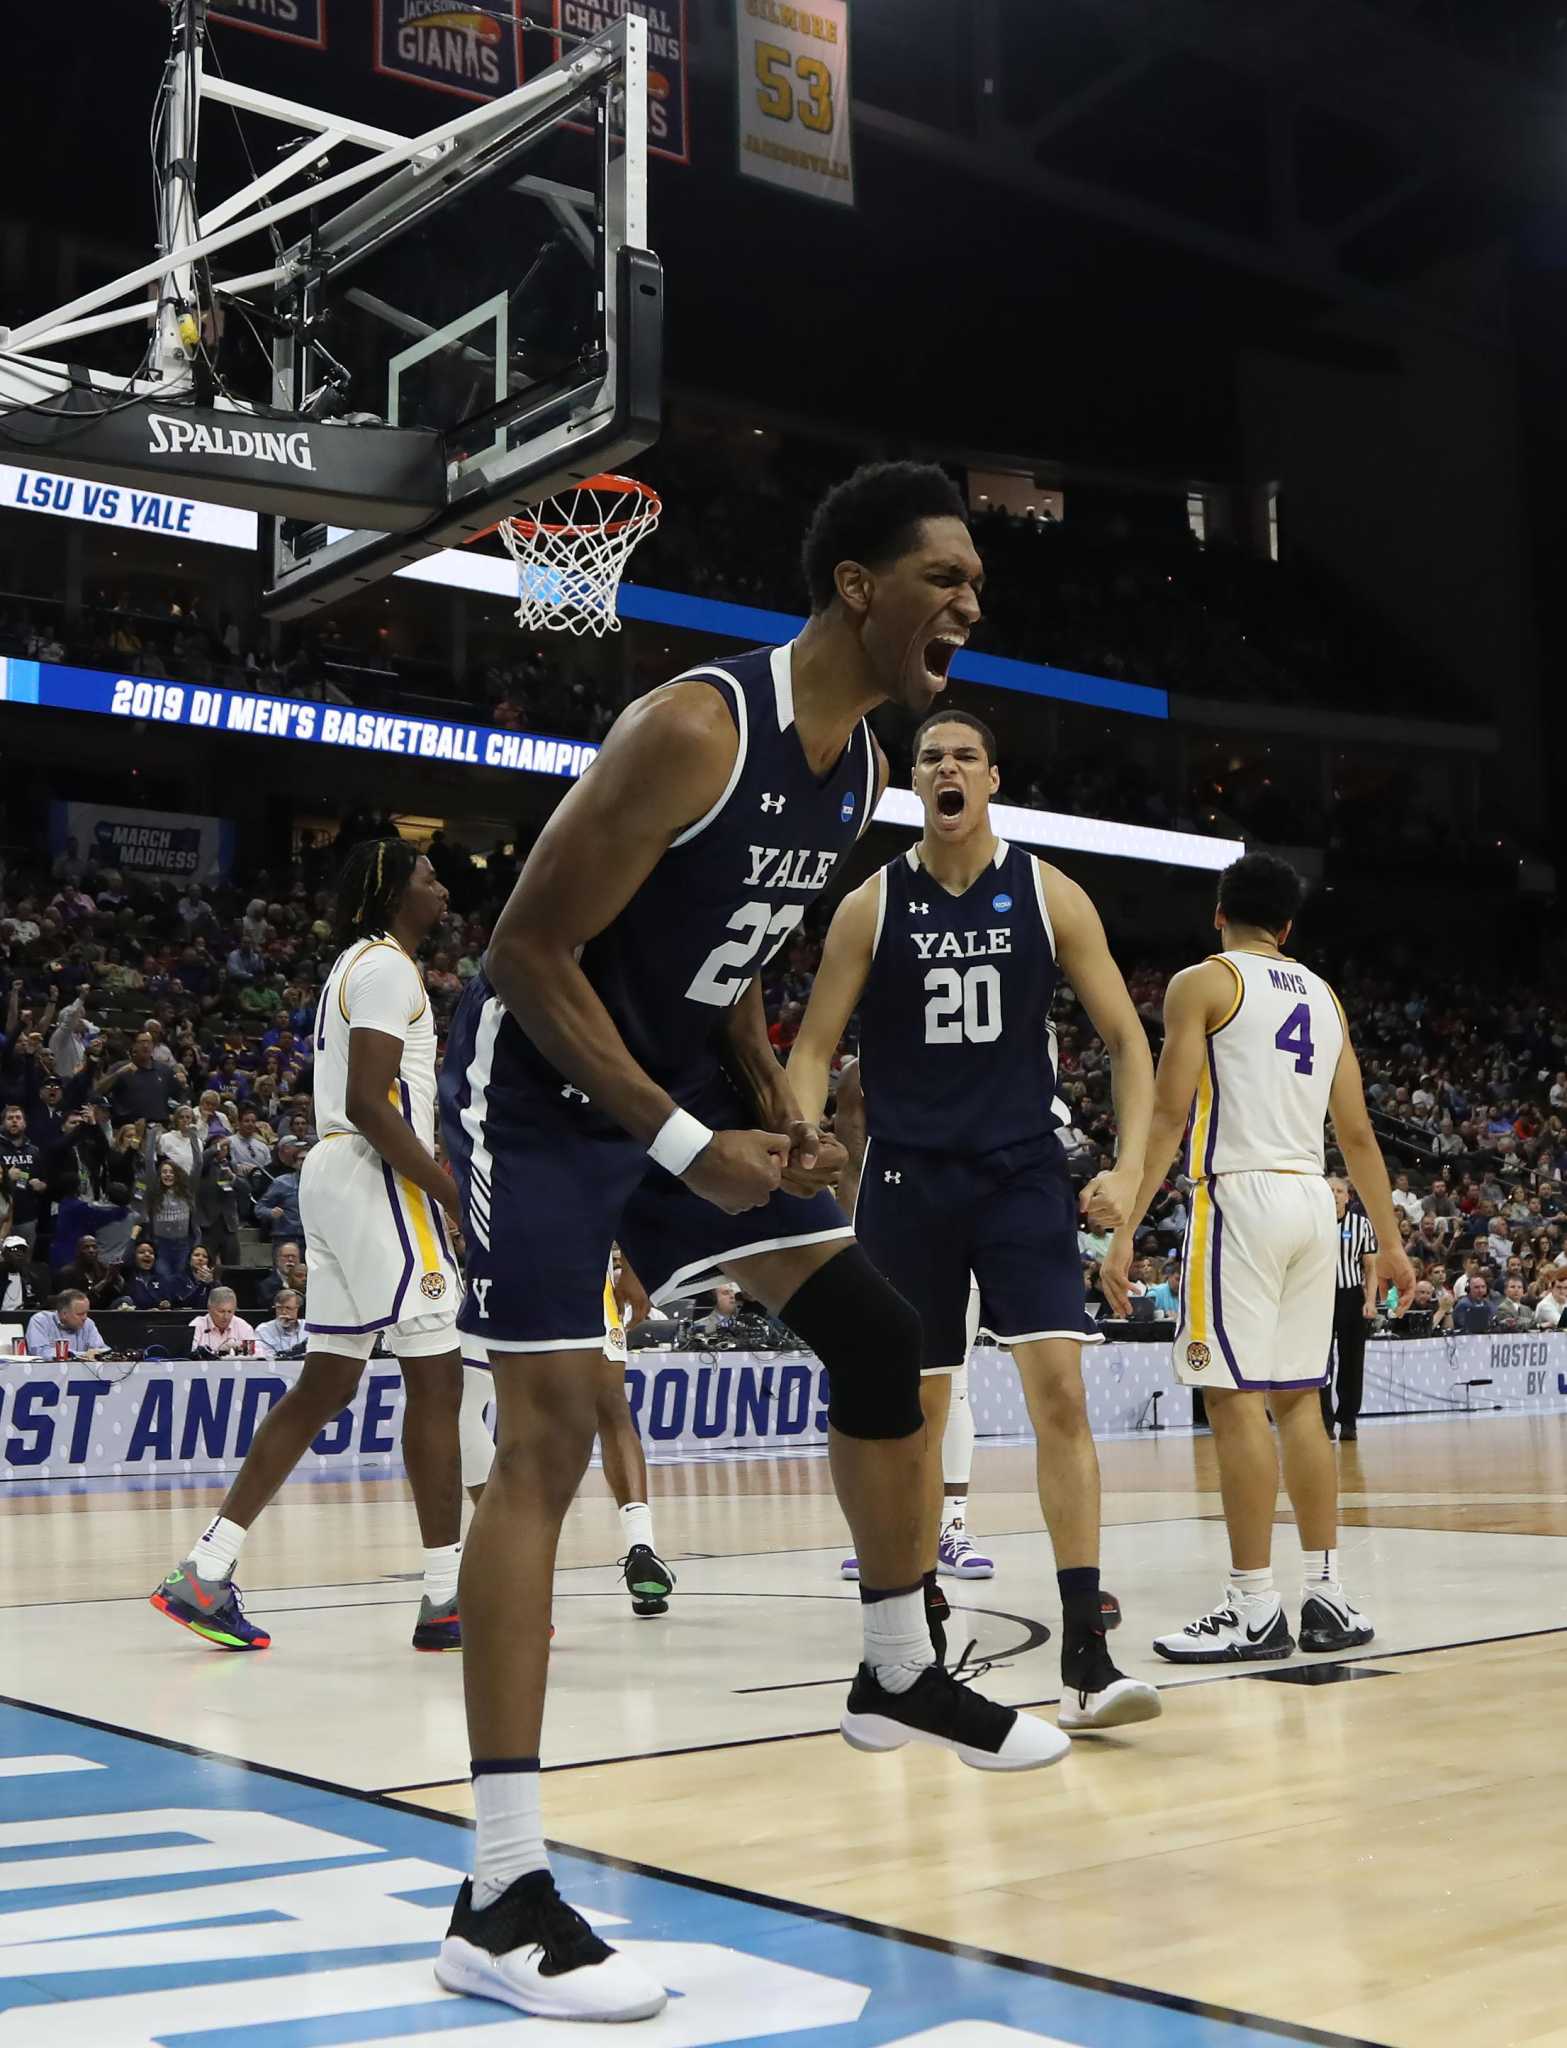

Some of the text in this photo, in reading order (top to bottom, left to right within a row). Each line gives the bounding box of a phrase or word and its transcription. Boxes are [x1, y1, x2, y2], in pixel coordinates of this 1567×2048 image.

[565, 0, 671, 33] ATIONAL
[754, 40, 835, 134] 53
[147, 413, 315, 471] SPALDING
[15, 473, 195, 533] LSU VS YALE
[111, 680, 184, 721] 2019
[189, 690, 222, 727] DI
[226, 696, 316, 739] MEN'S
[321, 709, 479, 763] BASKETBALL
[112, 826, 172, 848] MARCH
[120, 847, 199, 869] MADNESS
[743, 845, 839, 890] YALE
[910, 927, 1012, 959] YALE
[1268, 968, 1307, 995] MAYS
[924, 964, 1003, 1044] 20
[1275, 1003, 1315, 1076] 4
[3, 1154, 33, 1165] YALE
[473, 1279, 493, 1319] Y
[1490, 1343, 1548, 1369] HOSTED
[1527, 1371, 1547, 1396] BY
[0, 1380, 112, 1466] ST
